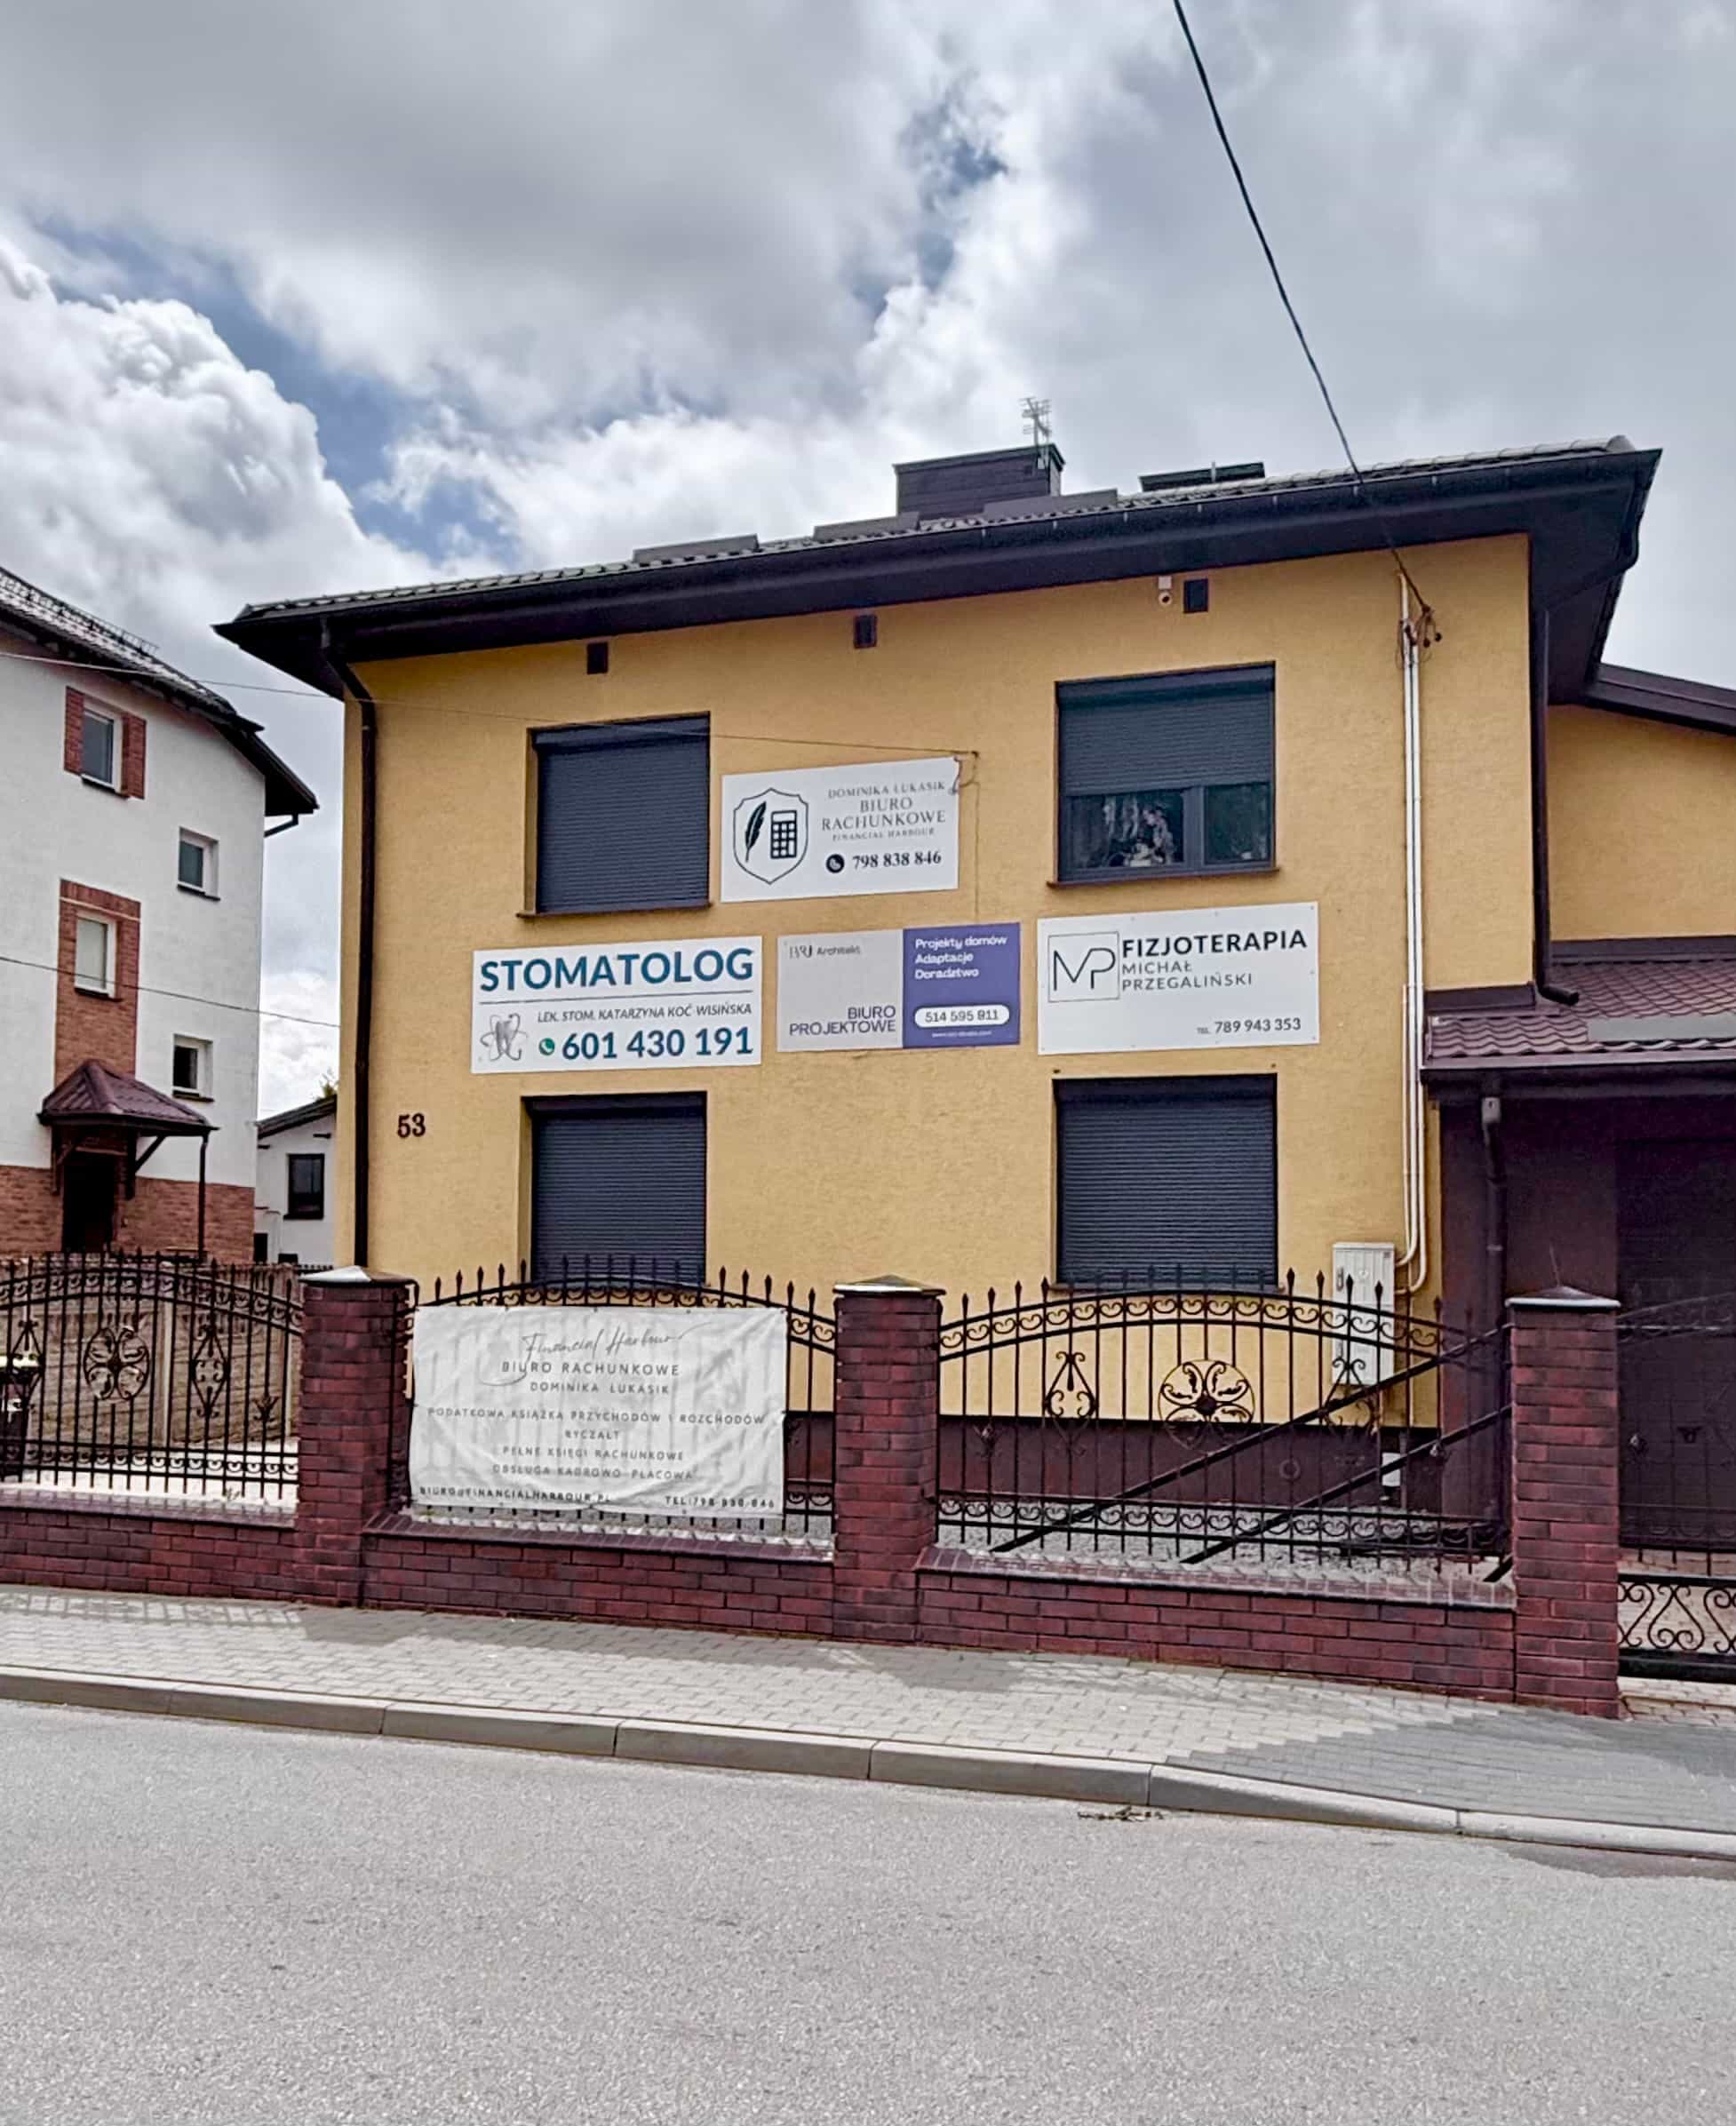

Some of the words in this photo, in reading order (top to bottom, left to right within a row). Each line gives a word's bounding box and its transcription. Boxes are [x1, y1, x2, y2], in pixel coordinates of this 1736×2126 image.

[828, 785, 889, 799] DOMINIKA
[860, 797, 913, 813] BIURO
[822, 809, 946, 831] RACHUNKOWE
[852, 854, 879, 870] 798
[883, 852, 910, 867] 838
[914, 850, 942, 865] 846
[915, 937, 963, 951] Projekty
[965, 936, 1007, 946] domów
[1122, 929, 1307, 958] FIZJOTERAPIA
[915, 952, 974, 965] Adaptacje
[480, 947, 754, 992] STOMATOLOG
[1122, 960, 1192, 975] MICHAŁ
[1122, 972, 1253, 991] PRZEGALIŃSKI
[598, 1007, 665, 1020] KATARZYNA
[668, 1004, 692, 1017] KOĆ
[697, 1001, 753, 1015] WISIŃSKA
[848, 1006, 896, 1020] BIURO
[925, 1012, 947, 1023] 514
[950, 1010, 975, 1022] 595
[789, 1019, 896, 1036] PROJEKTOWE
[1214, 1021, 1241, 1034] 789
[1244, 1019, 1270, 1031] 943
[1275, 1017, 1302, 1031] 353
[562, 1031, 617, 1060] 601
[626, 1028, 685, 1057] 430
[696, 1026, 753, 1055] 191
[397, 1112, 426, 1138] 53
[502, 1361, 553, 1374] BIURO
[561, 1362, 680, 1376] RACHUNKOWE
[530, 1382, 599, 1393] DOMINIKA
[594, 1449, 683, 1461] RACHUNKOWE
